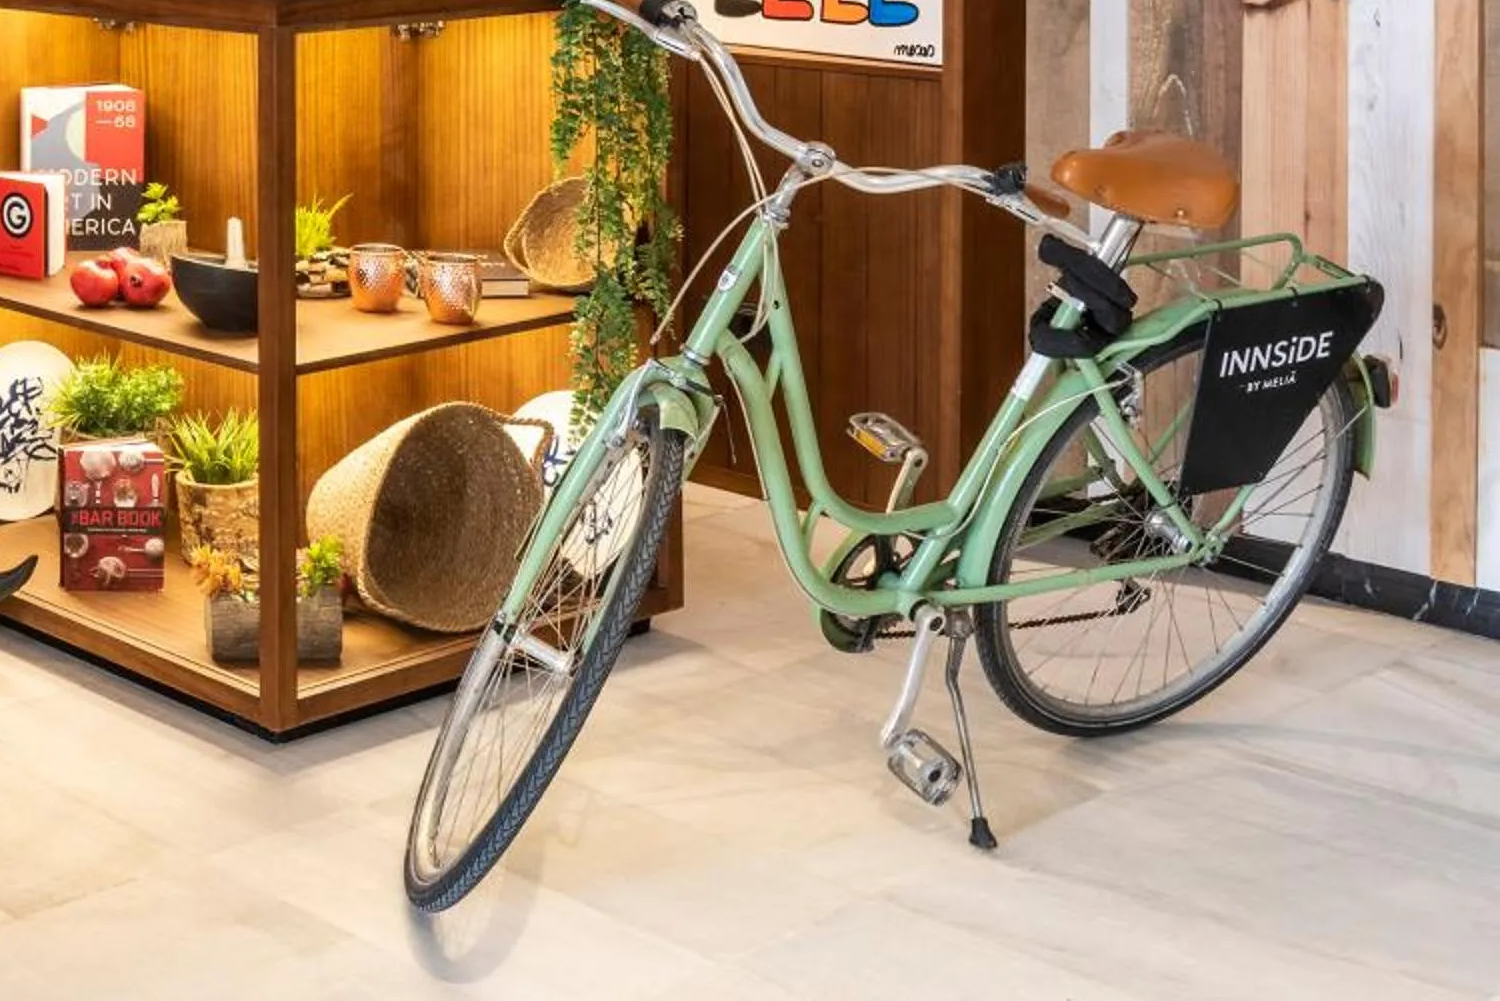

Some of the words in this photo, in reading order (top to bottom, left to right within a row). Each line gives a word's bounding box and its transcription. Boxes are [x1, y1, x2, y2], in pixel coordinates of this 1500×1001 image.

[38, 168, 137, 186] ODERN
[90, 193, 112, 211] IN
[66, 218, 136, 236] ERICA
[1247, 380, 1261, 392] BY
[79, 509, 113, 527] BAR
[118, 510, 162, 527] BOOK
